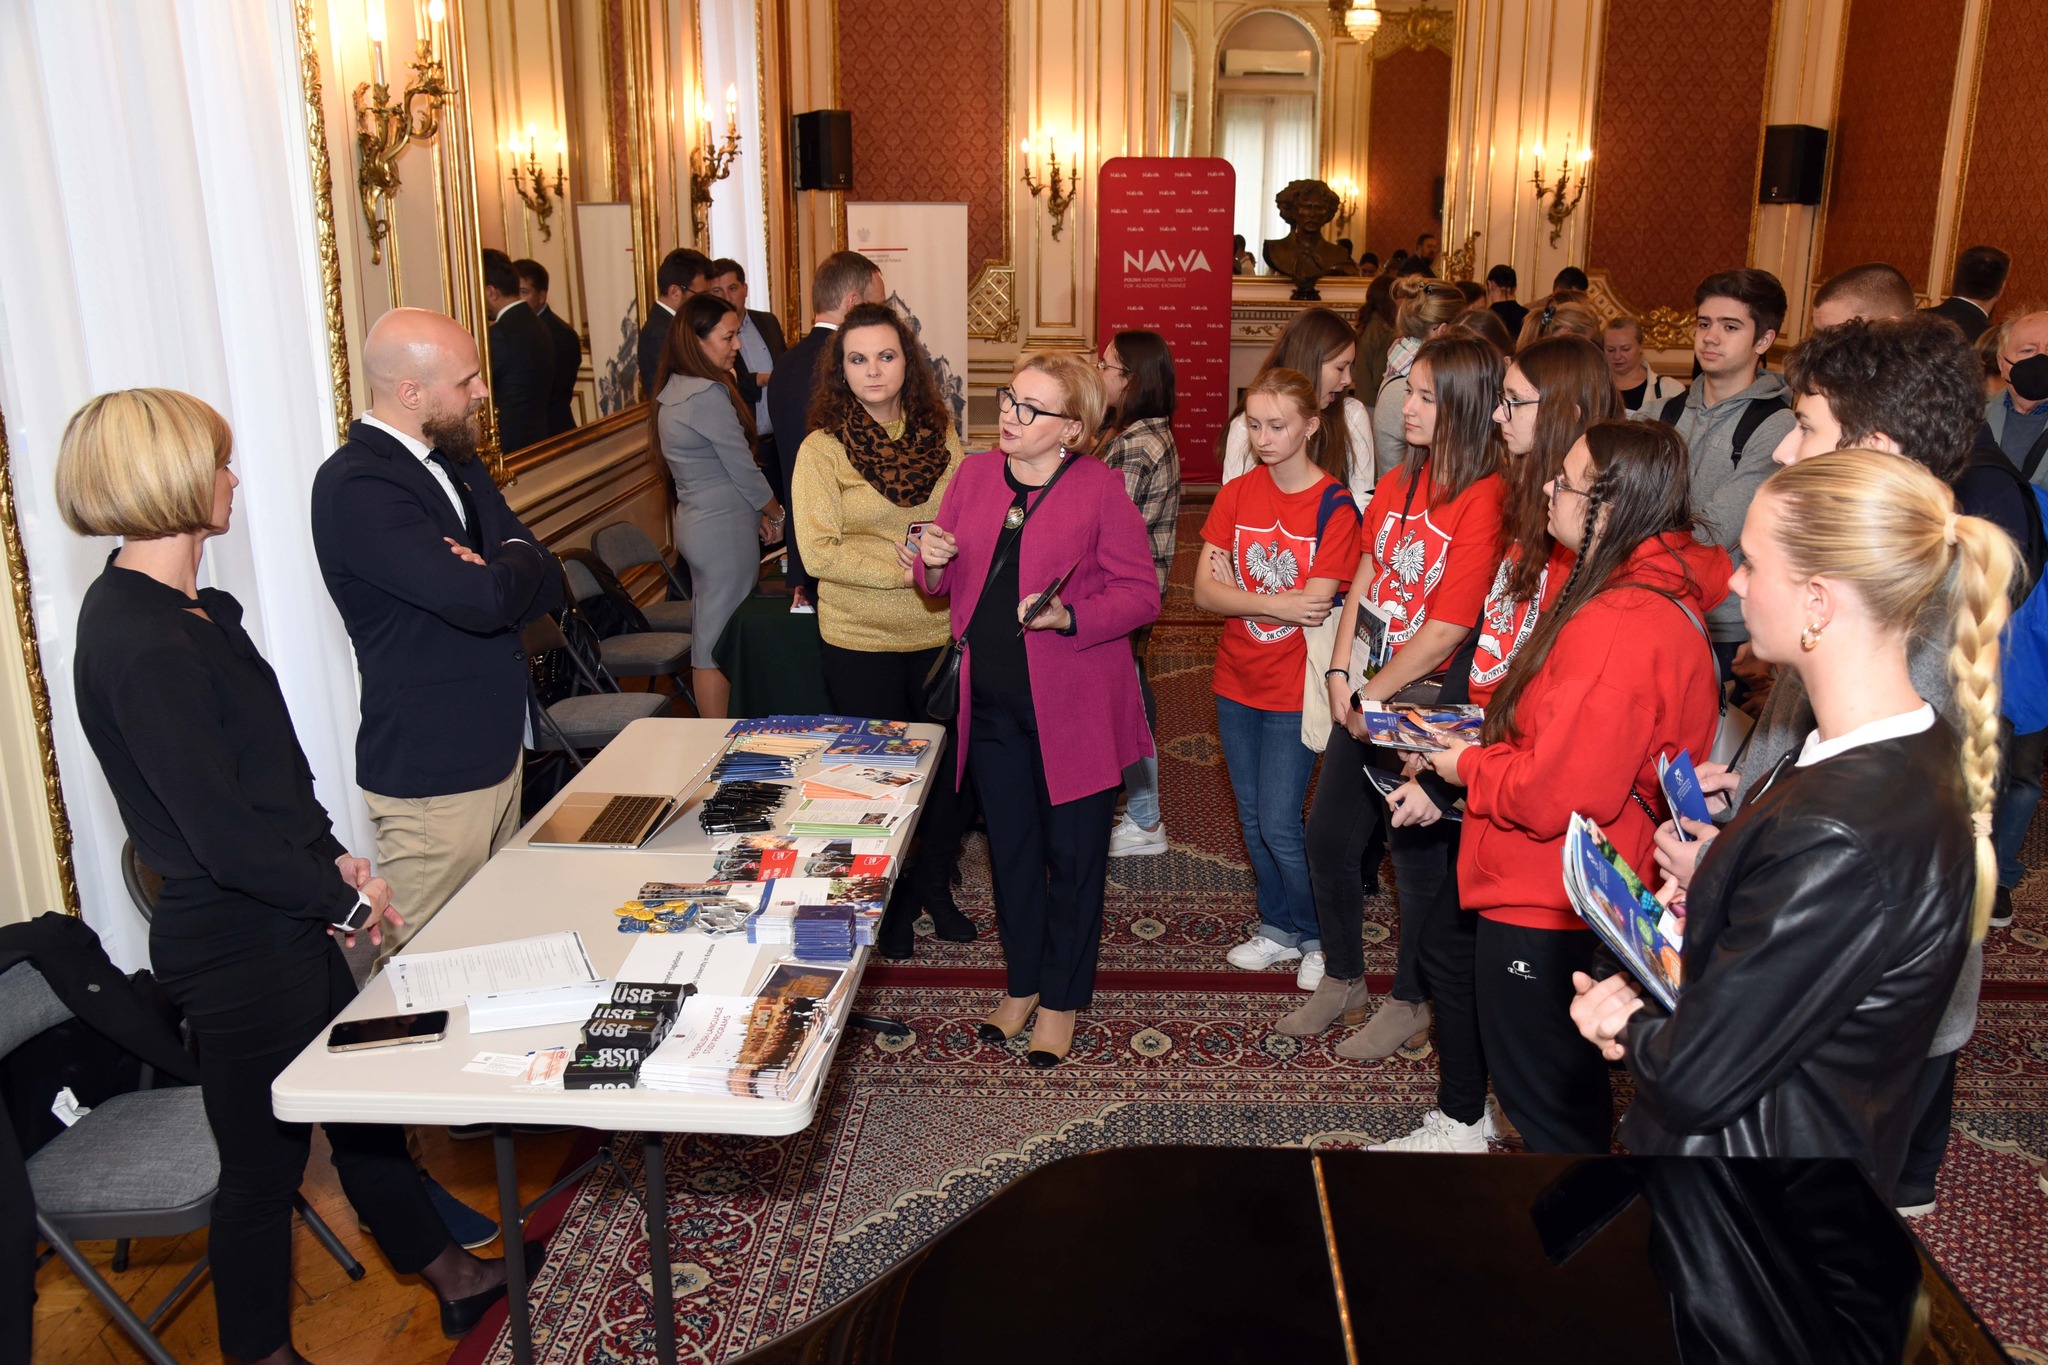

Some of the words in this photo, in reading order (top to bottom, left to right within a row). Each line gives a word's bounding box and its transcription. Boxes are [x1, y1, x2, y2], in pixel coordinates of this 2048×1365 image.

[1124, 249, 1212, 273] NAWA
[1378, 530, 1389, 554] POLSKA
[1276, 625, 1292, 637] CYRYL
[613, 987, 655, 1004] USB
[595, 1008, 637, 1020] USB
[589, 1021, 632, 1038] USB
[711, 1015, 731, 1041] PROGRAMS
